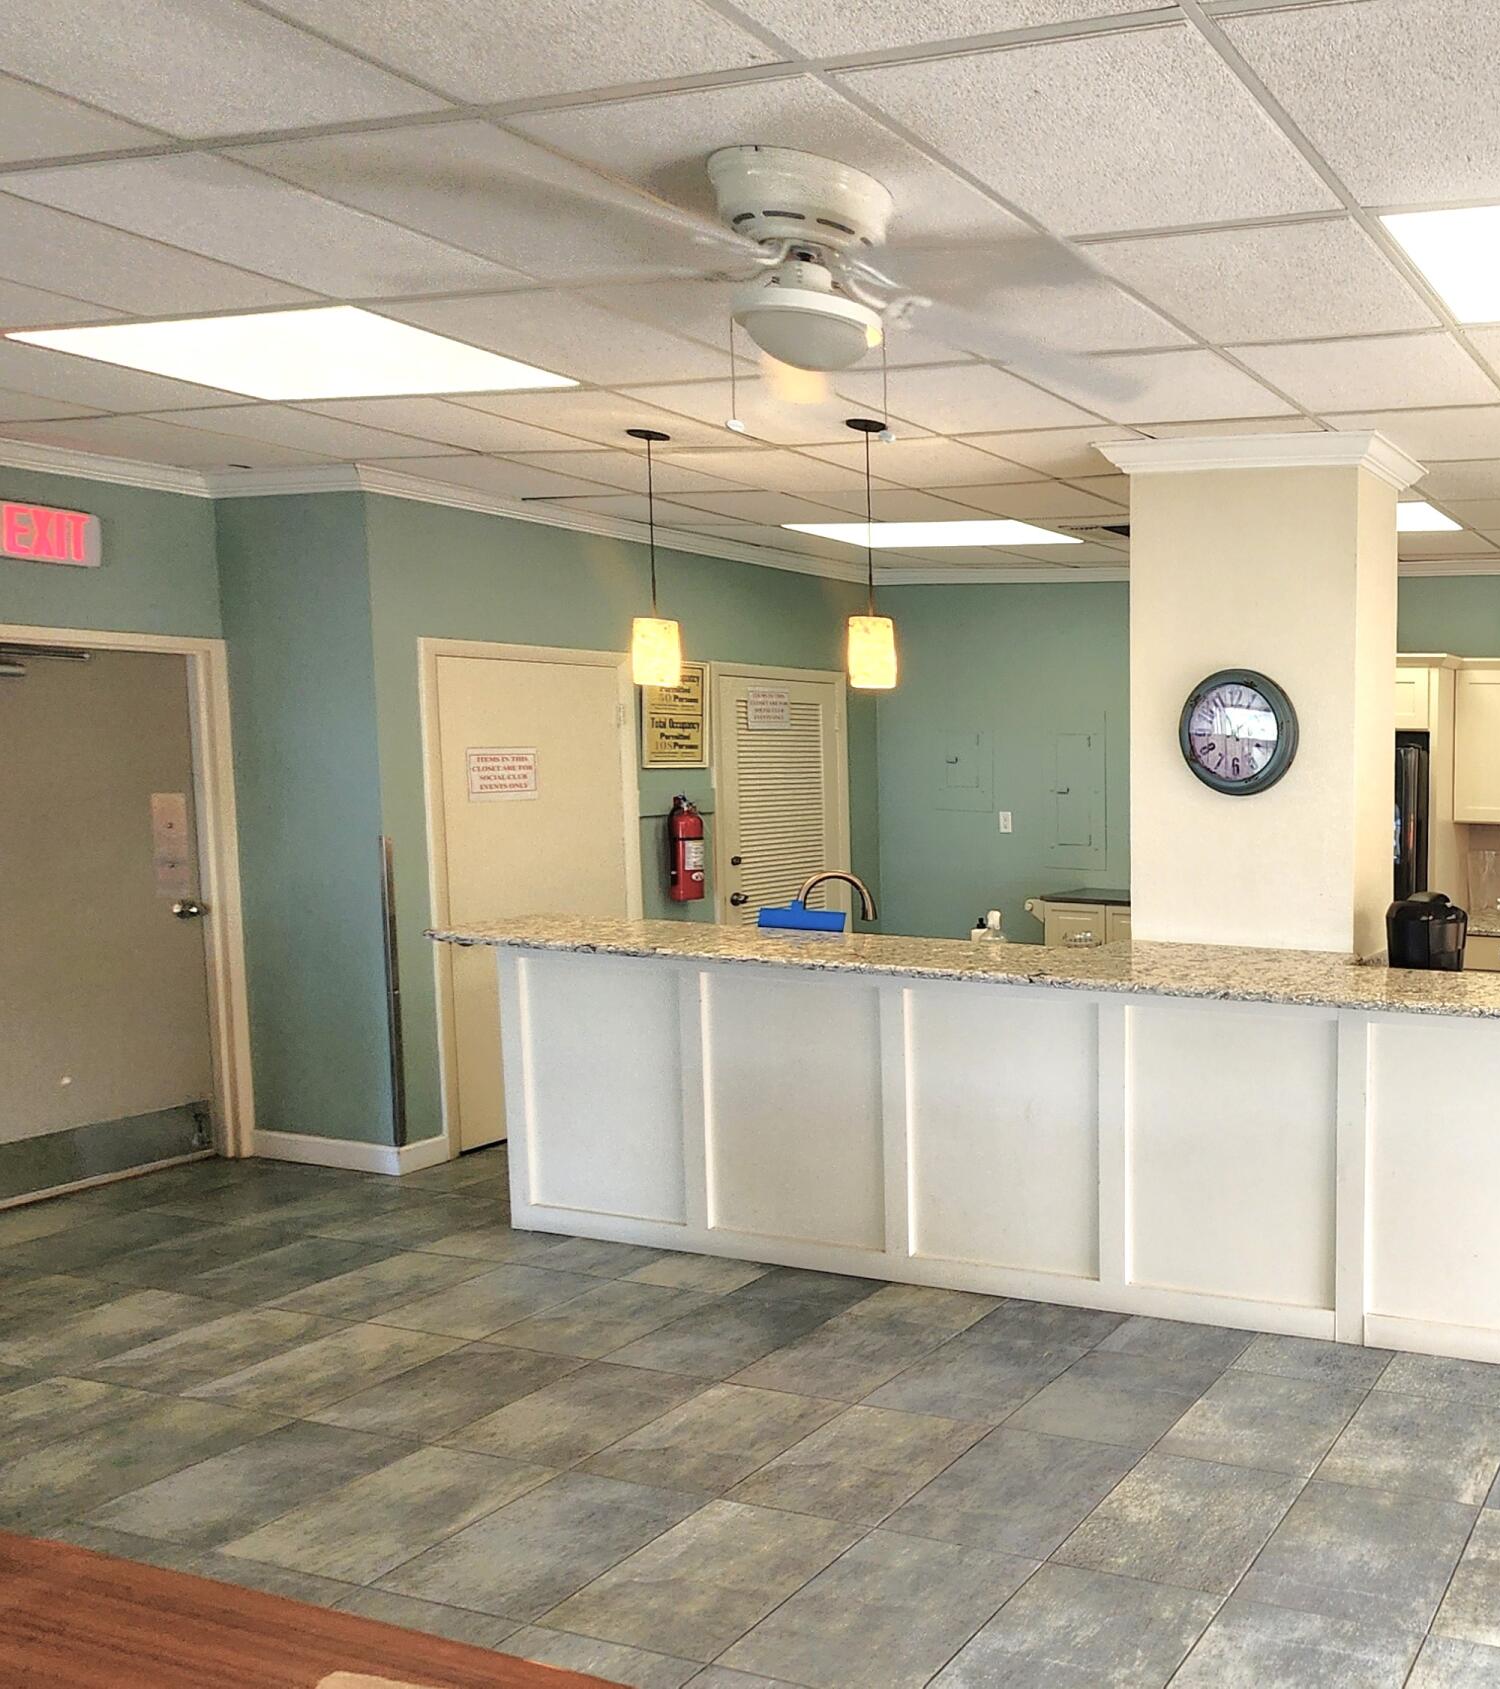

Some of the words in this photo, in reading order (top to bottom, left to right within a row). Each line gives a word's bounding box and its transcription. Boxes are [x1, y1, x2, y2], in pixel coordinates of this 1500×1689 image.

[3, 503, 91, 561] EXIT
[651, 717, 667, 729] Total
[668, 718, 700, 733] Occupancy
[1231, 757, 1240, 776] 6
